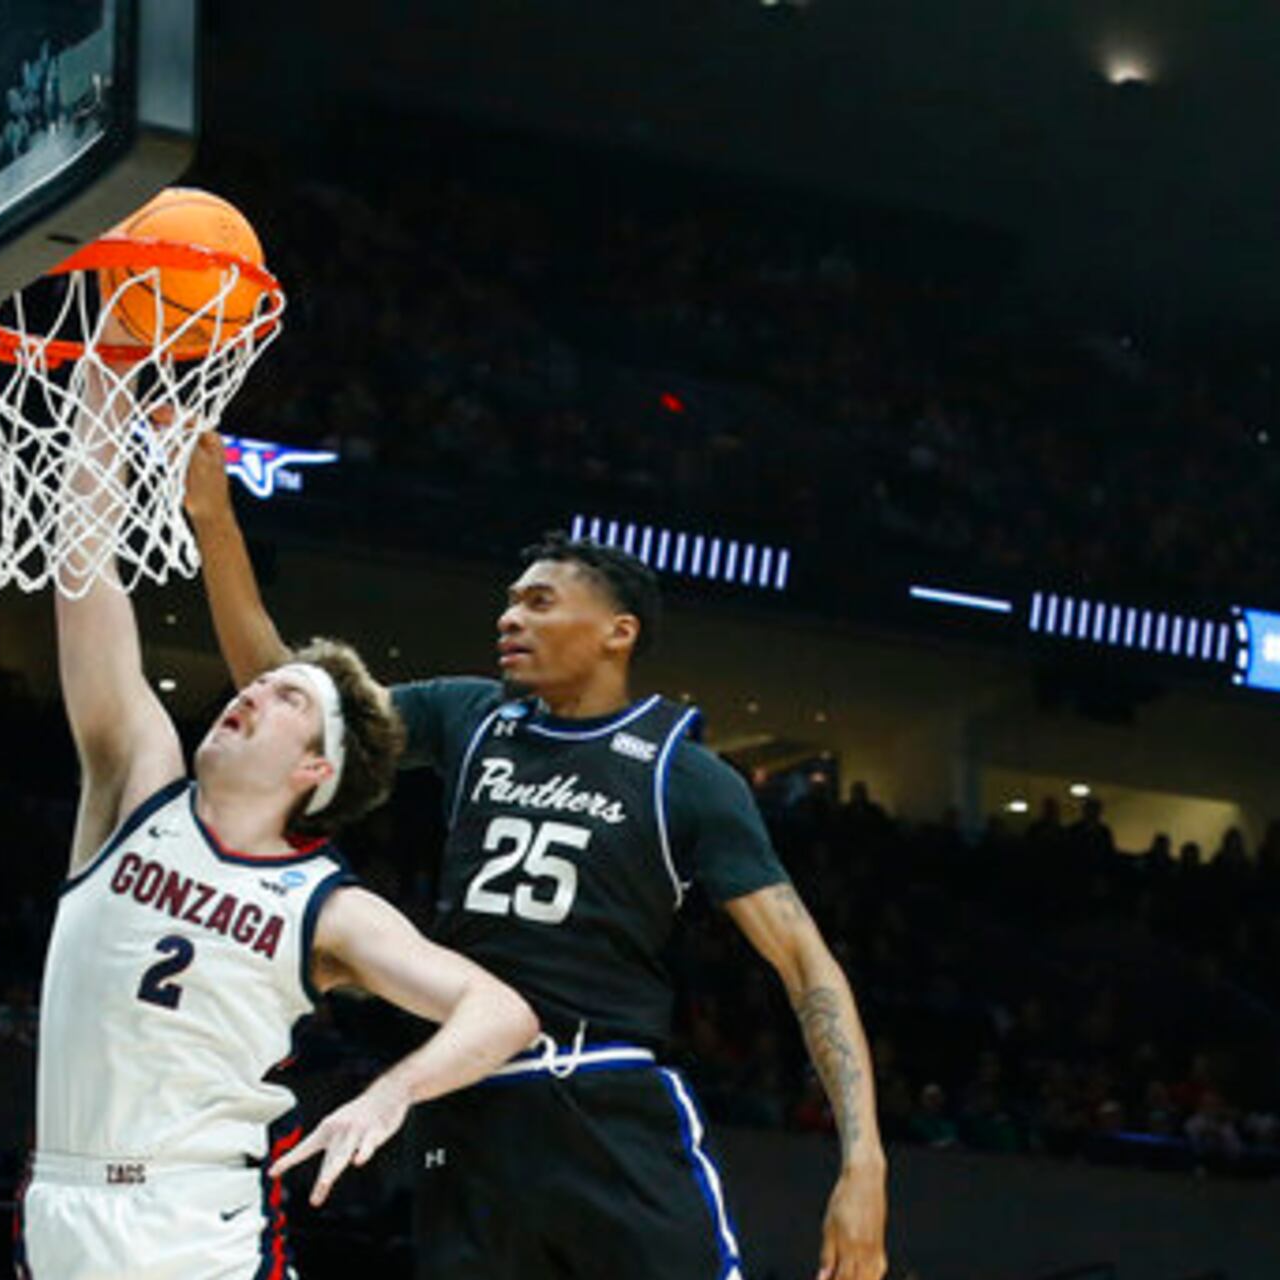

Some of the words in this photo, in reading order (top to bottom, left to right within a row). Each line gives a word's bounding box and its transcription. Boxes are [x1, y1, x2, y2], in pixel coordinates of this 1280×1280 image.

[471, 758, 626, 824] Panthers
[111, 852, 286, 960] GONZAGA
[463, 816, 592, 924] 25
[136, 934, 195, 1011] 2
